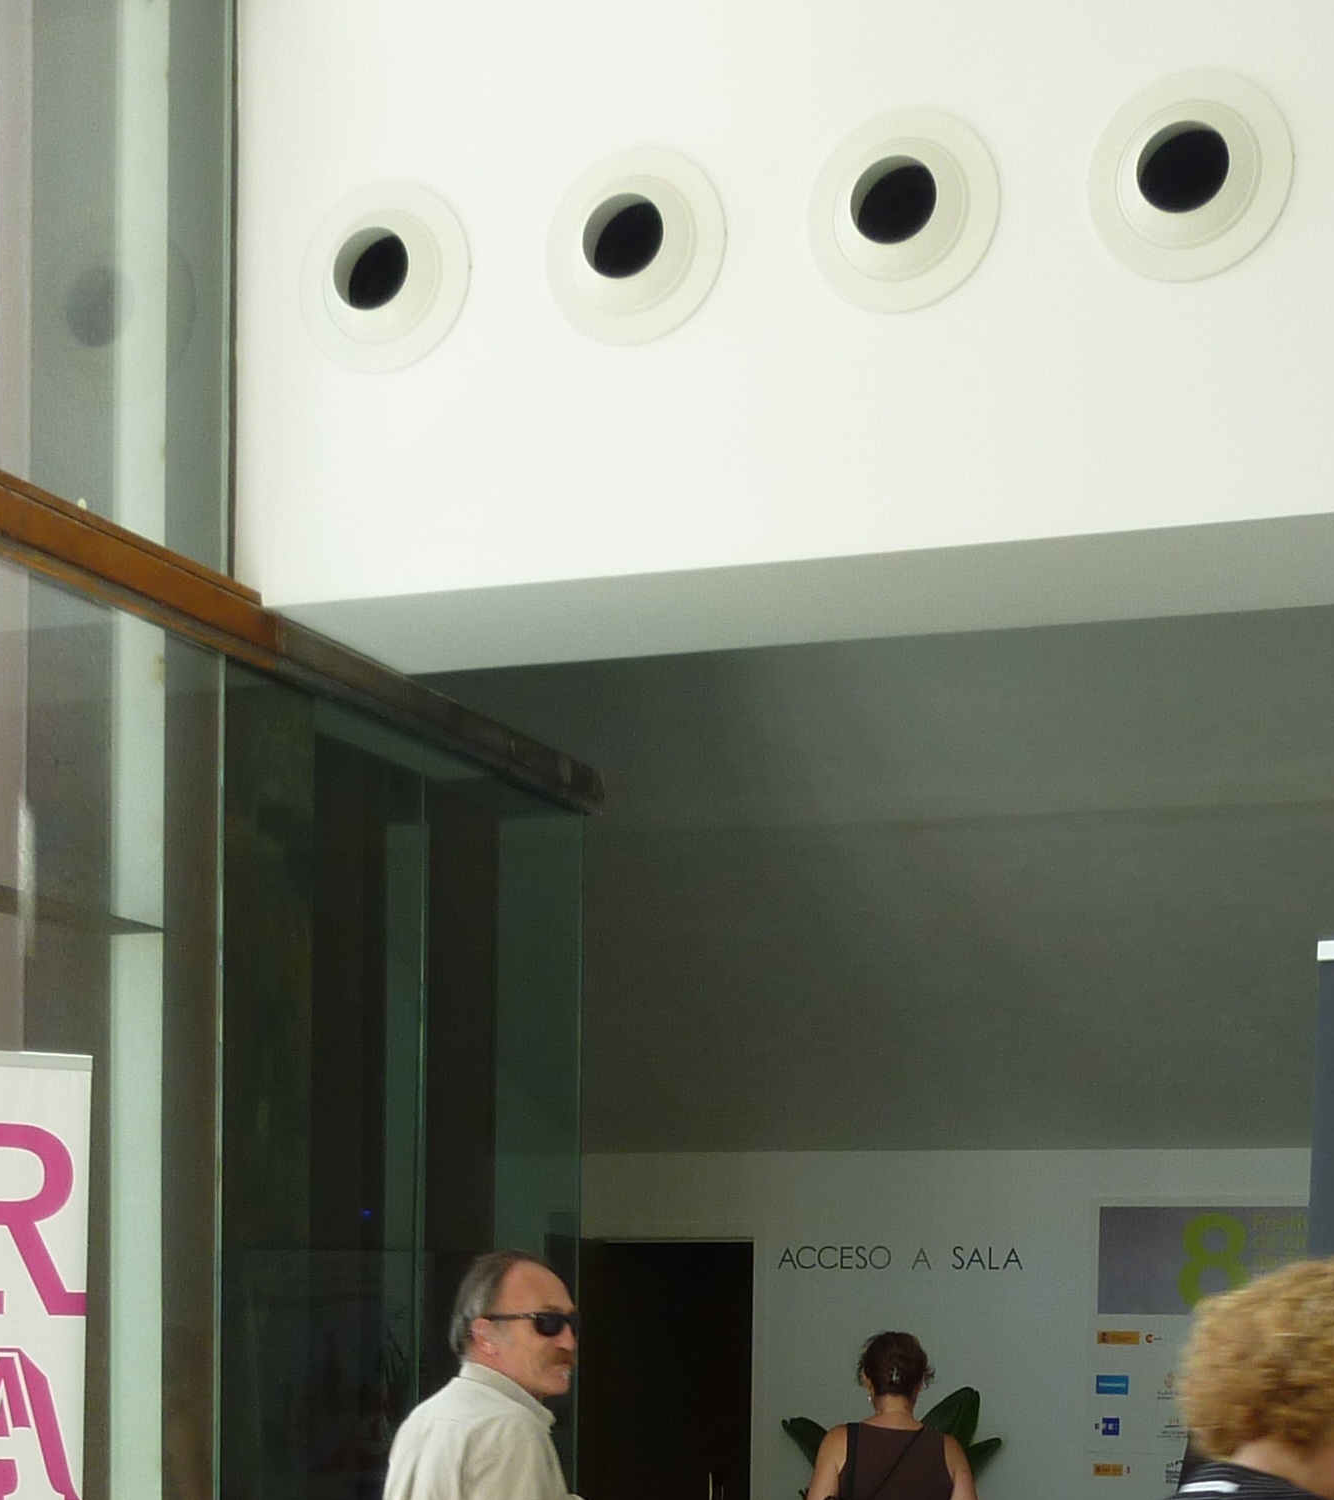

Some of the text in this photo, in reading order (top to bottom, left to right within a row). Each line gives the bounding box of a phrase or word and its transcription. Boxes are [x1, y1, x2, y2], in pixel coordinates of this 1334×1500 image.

[777, 1245, 1024, 1271] ACCESO A SALA
[1178, 1212, 1251, 1308] 8
